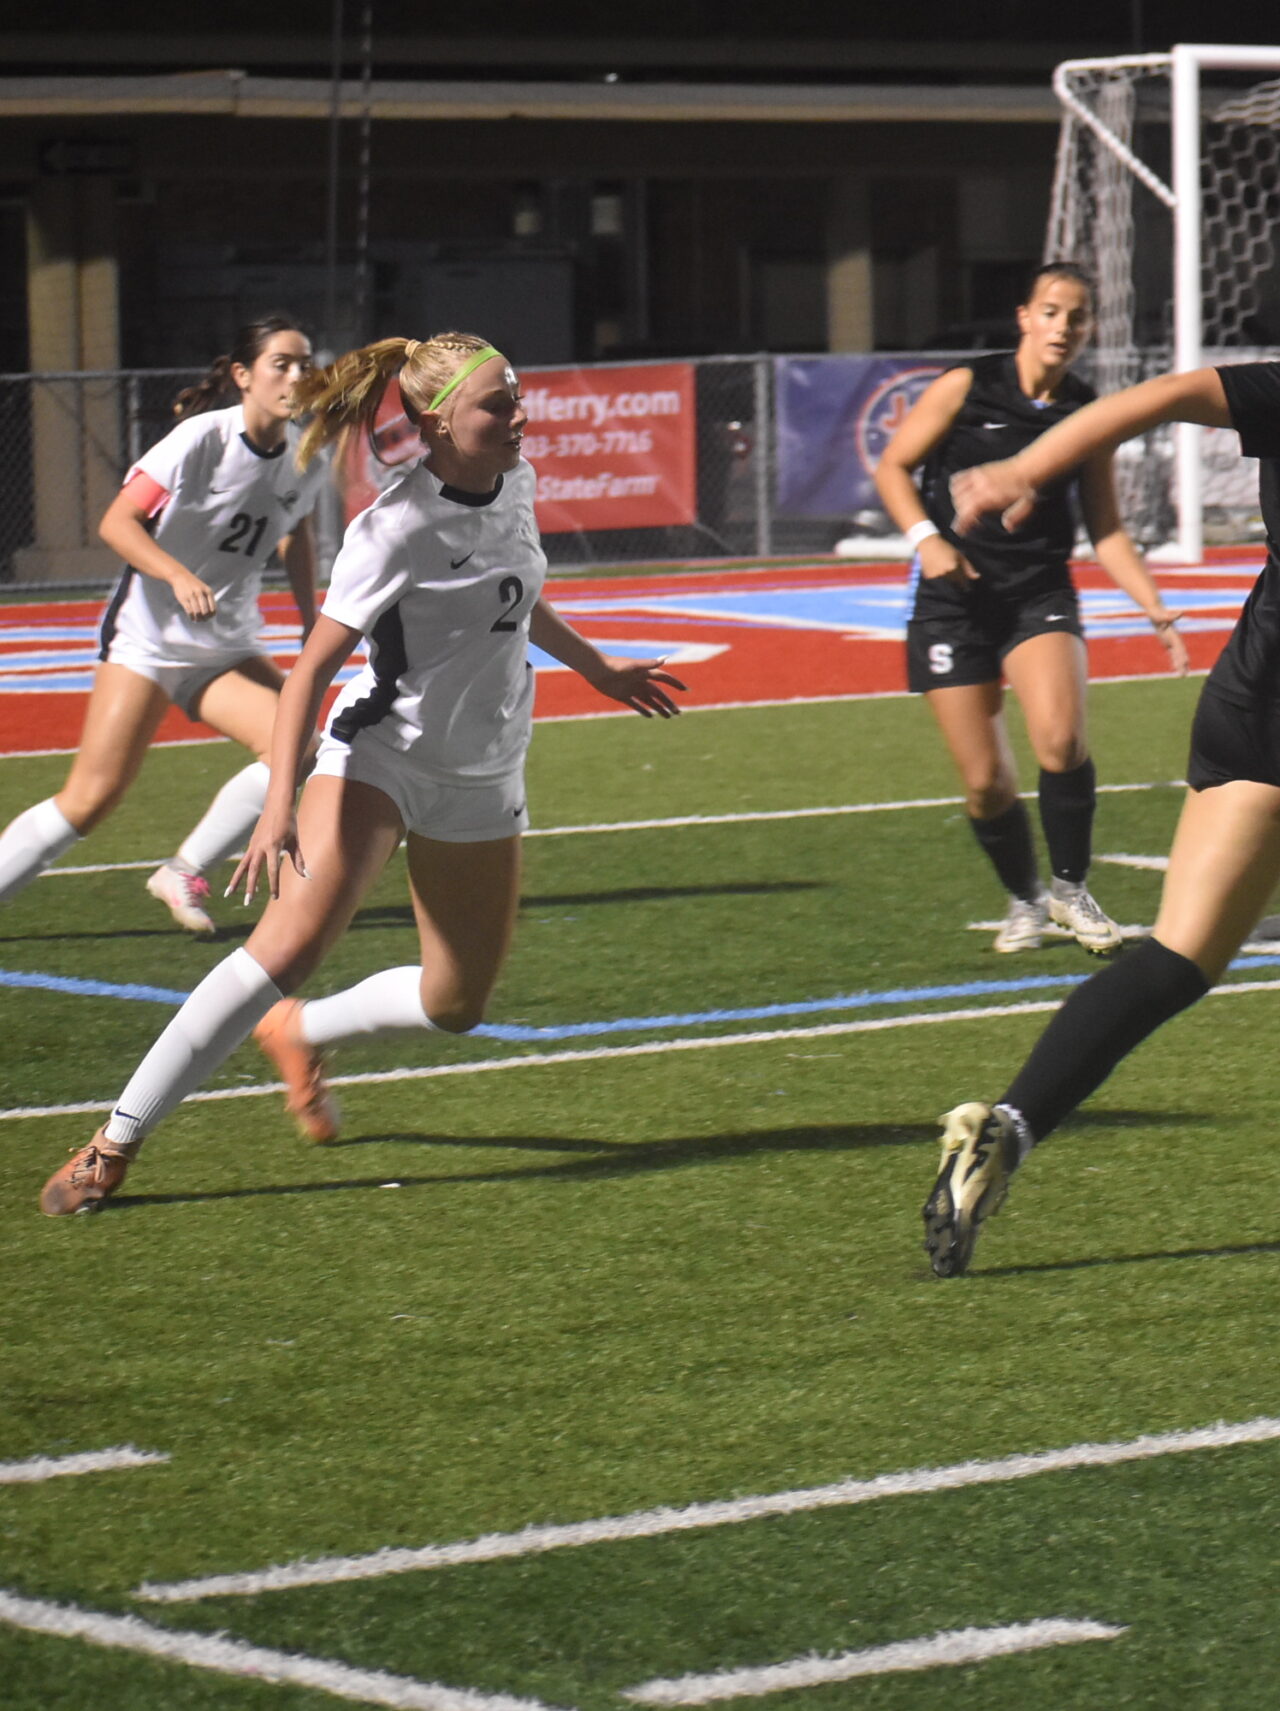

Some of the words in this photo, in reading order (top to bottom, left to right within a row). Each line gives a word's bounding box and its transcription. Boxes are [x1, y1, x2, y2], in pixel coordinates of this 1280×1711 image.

[218, 512, 268, 557] 21
[489, 575, 523, 633] 2
[928, 643, 954, 675] S
